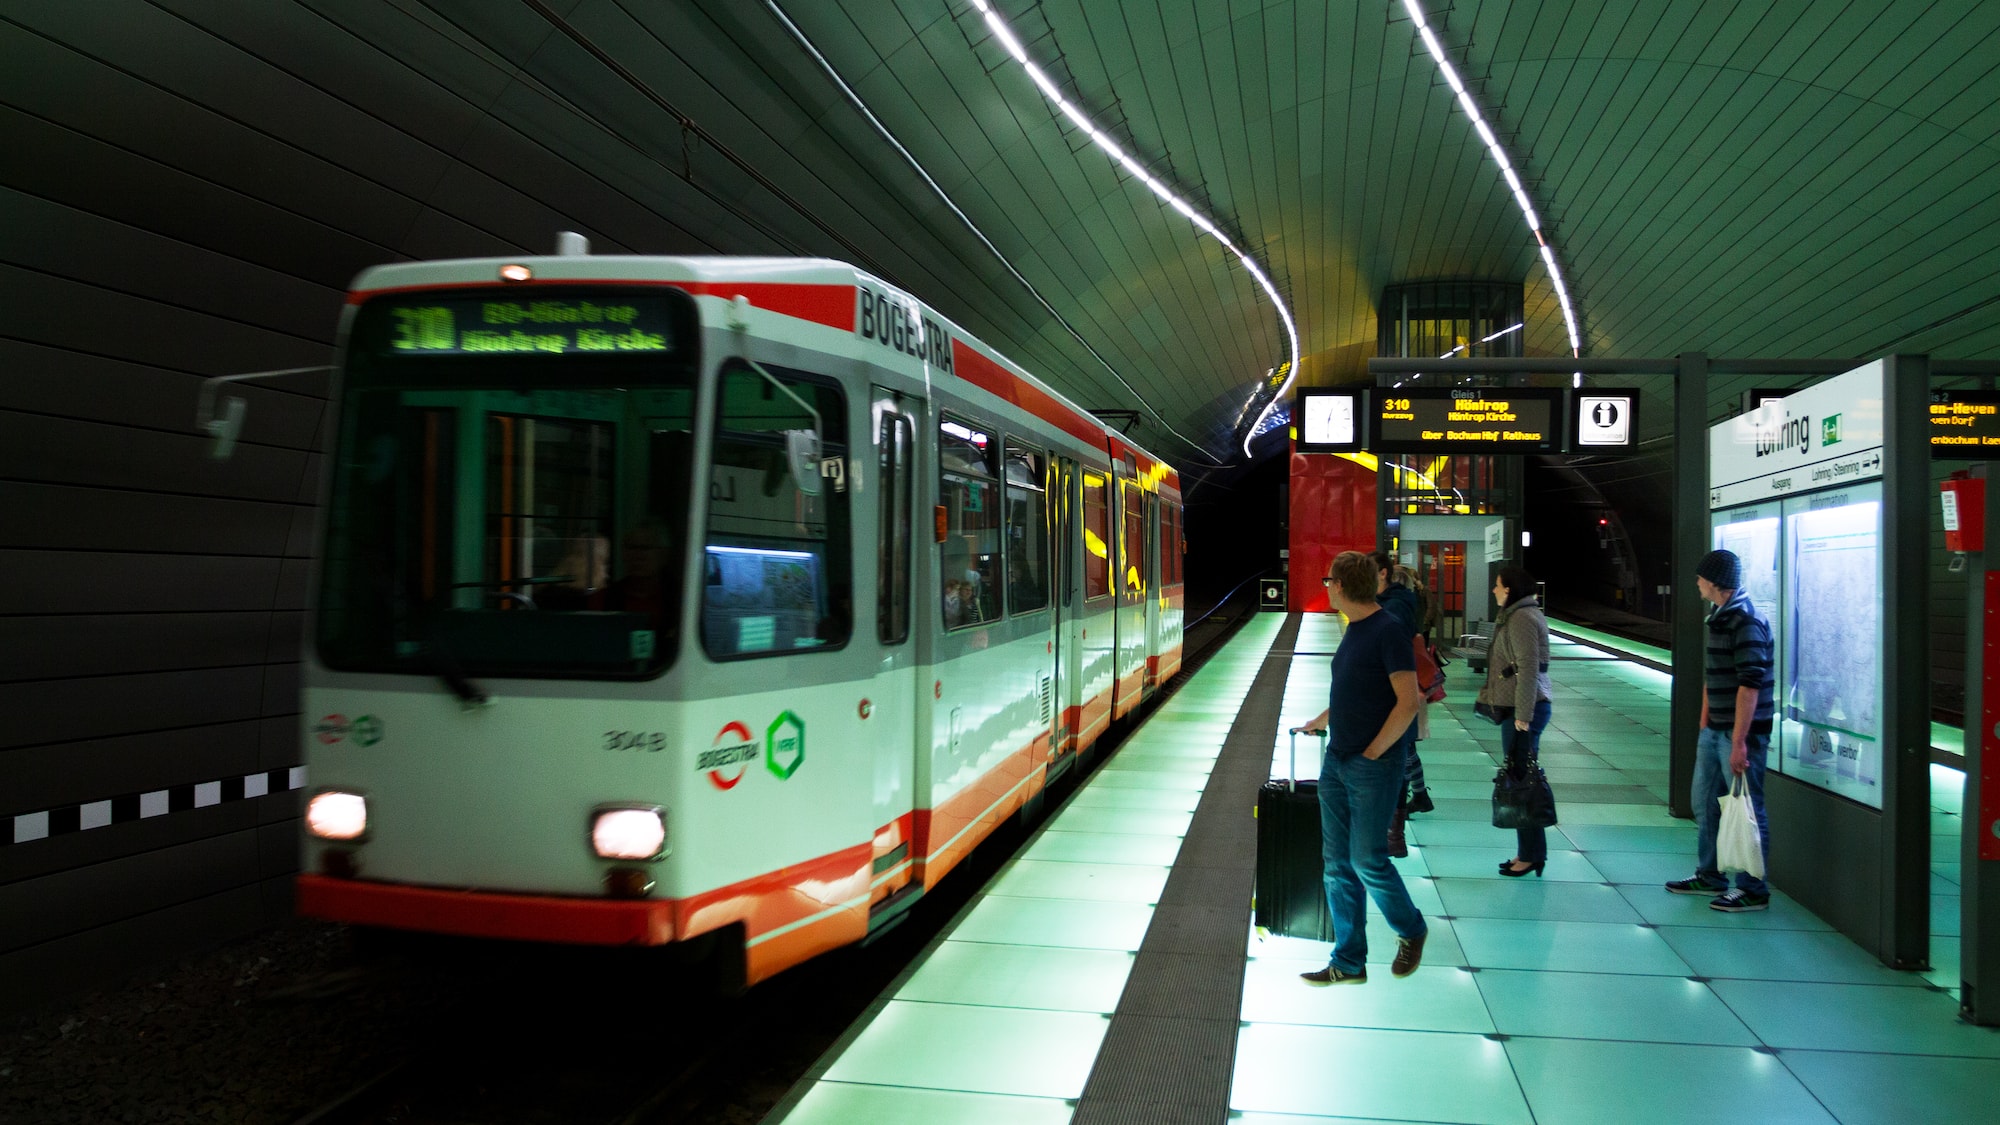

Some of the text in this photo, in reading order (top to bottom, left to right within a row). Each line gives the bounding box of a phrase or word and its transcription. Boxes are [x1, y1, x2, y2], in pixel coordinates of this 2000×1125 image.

[392, 306, 455, 349] 310
[1451, 390, 1482, 399] Gleis 1
[1942, 393, 1949, 402] 2
[1385, 399, 1509, 413] 310 Höntrop
[1448, 412, 1517, 422] Höntrop Kirche
[1951, 416, 1975, 427] Dorf
[1447, 431, 1481, 440] Bochum
[1482, 431, 1500, 442] Hbf
[1503, 431, 1541, 440] Rathaus
[1756, 410, 1810, 457] Lohring
